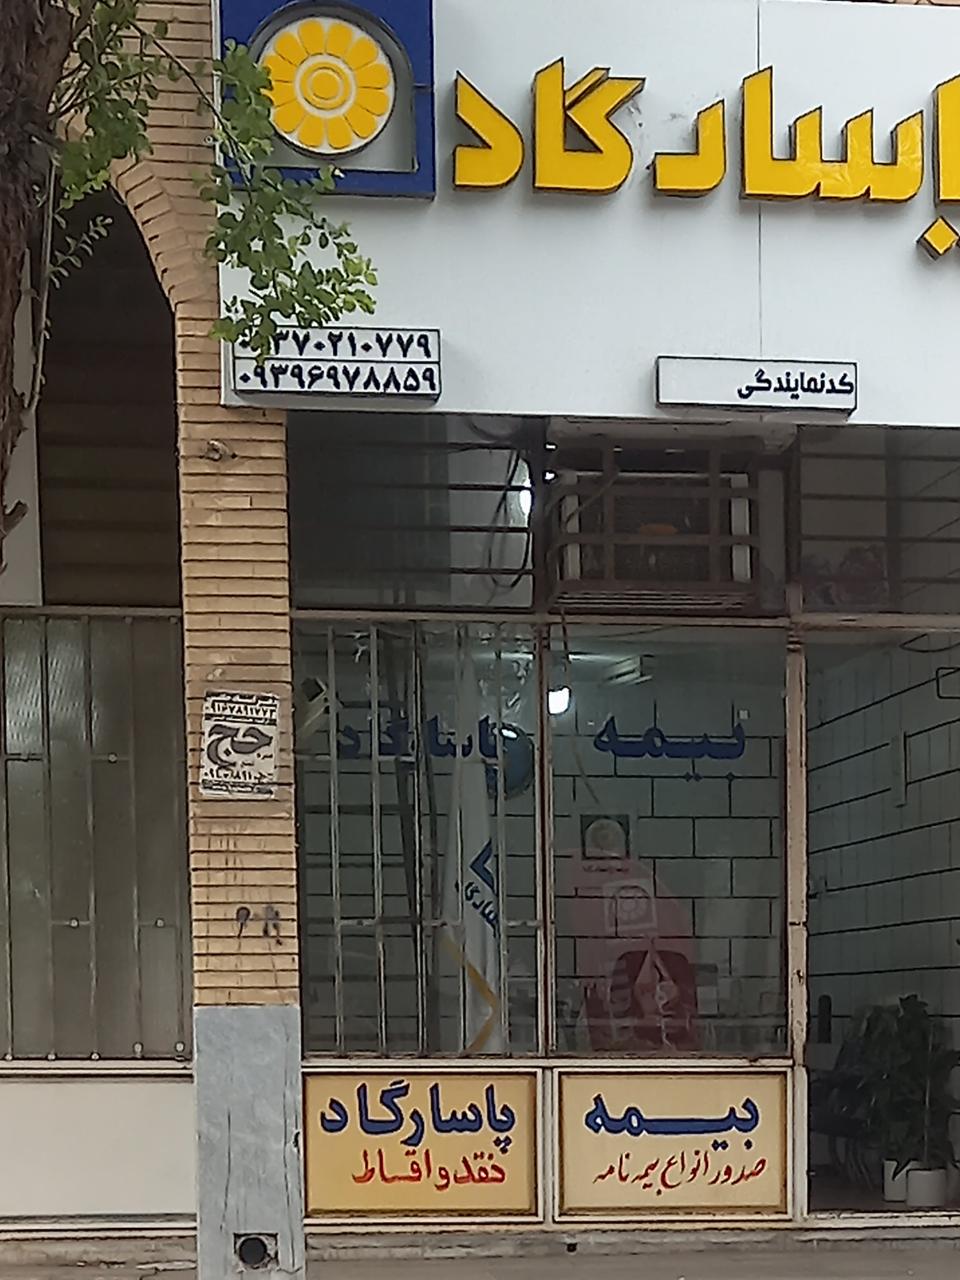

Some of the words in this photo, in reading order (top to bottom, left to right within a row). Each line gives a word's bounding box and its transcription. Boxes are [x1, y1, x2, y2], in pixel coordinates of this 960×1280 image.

[239, 330, 431, 358] ۰۳۷۰۲۱۰۷۷۹
[239, 363, 436, 392] ۰۹۳۹۶۹۷۸۸۵۹
[320, 1080, 515, 1154] پاسارگاد
[585, 1094, 759, 1150] بیمه
[660, 1150, 709, 1189] انواع
[708, 1157, 767, 1186] صدور
